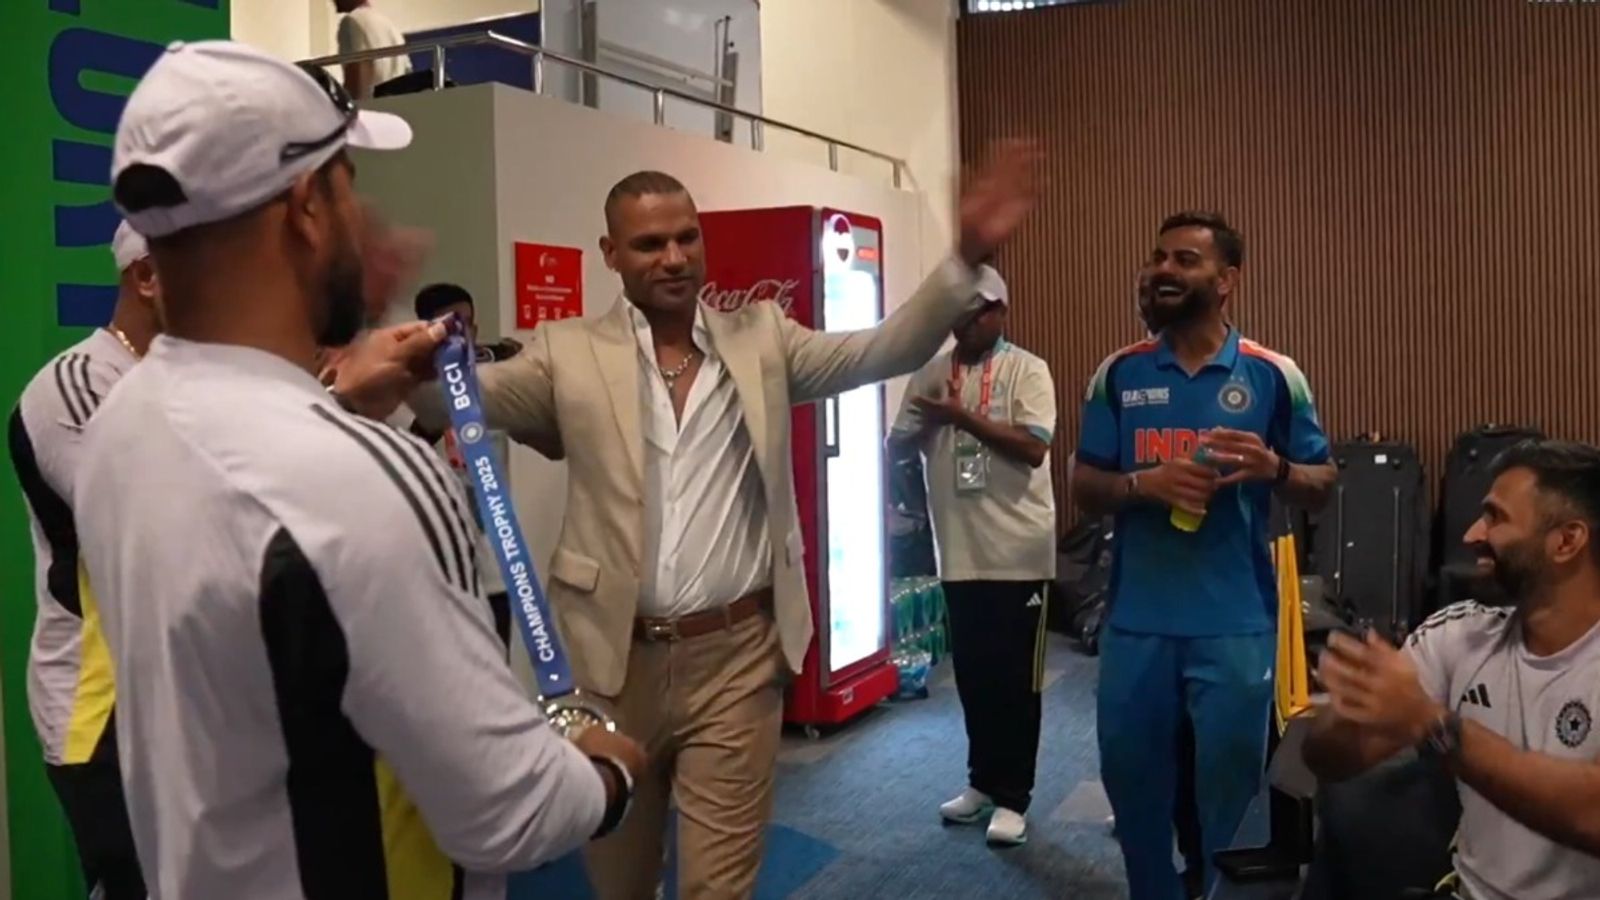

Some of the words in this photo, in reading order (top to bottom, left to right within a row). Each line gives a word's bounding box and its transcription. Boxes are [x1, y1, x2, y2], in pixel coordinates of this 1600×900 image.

[444, 362, 471, 410] BCCI
[1135, 428, 1208, 463] IND
[475, 456, 499, 493] 2025
[486, 494, 521, 561] TROPHY
[509, 560, 555, 663] CHAMPIONS
